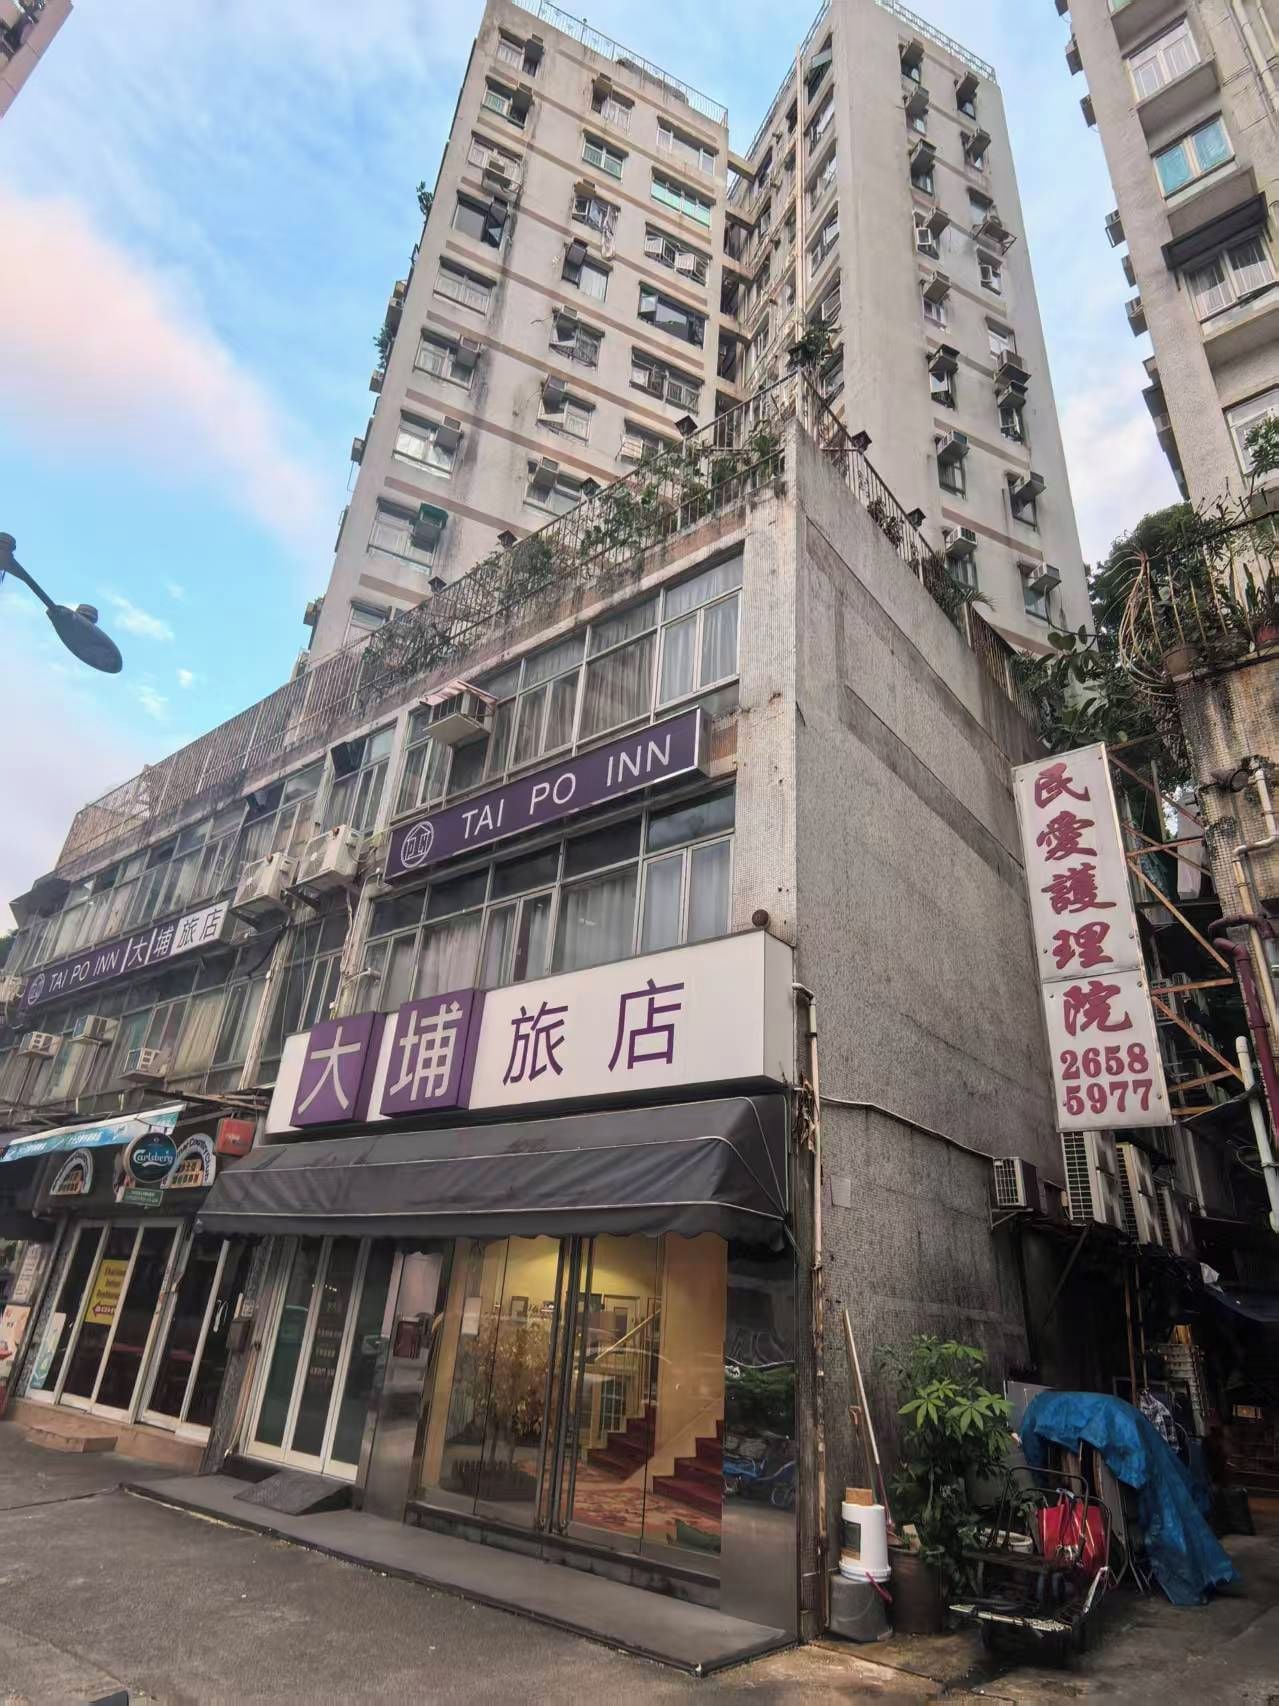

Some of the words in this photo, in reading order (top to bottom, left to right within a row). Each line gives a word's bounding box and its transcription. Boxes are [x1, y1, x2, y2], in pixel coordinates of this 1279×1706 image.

[462, 798, 504, 839] TAI
[529, 772, 576, 815] PO
[606, 734, 671, 787] INN
[1034, 762, 1133, 1036] 民愛護理院
[128, 908, 223, 967] 大埔旅店
[48, 972, 67, 993] TAI
[70, 960, 90, 985] PO
[93, 949, 120, 977] INN
[297, 978, 685, 1114] 大埔旅店
[1060, 1042, 1149, 1080] 2658
[1063, 1078, 1153, 1116] 5977
[133, 1149, 173, 1165] Carlsberg
